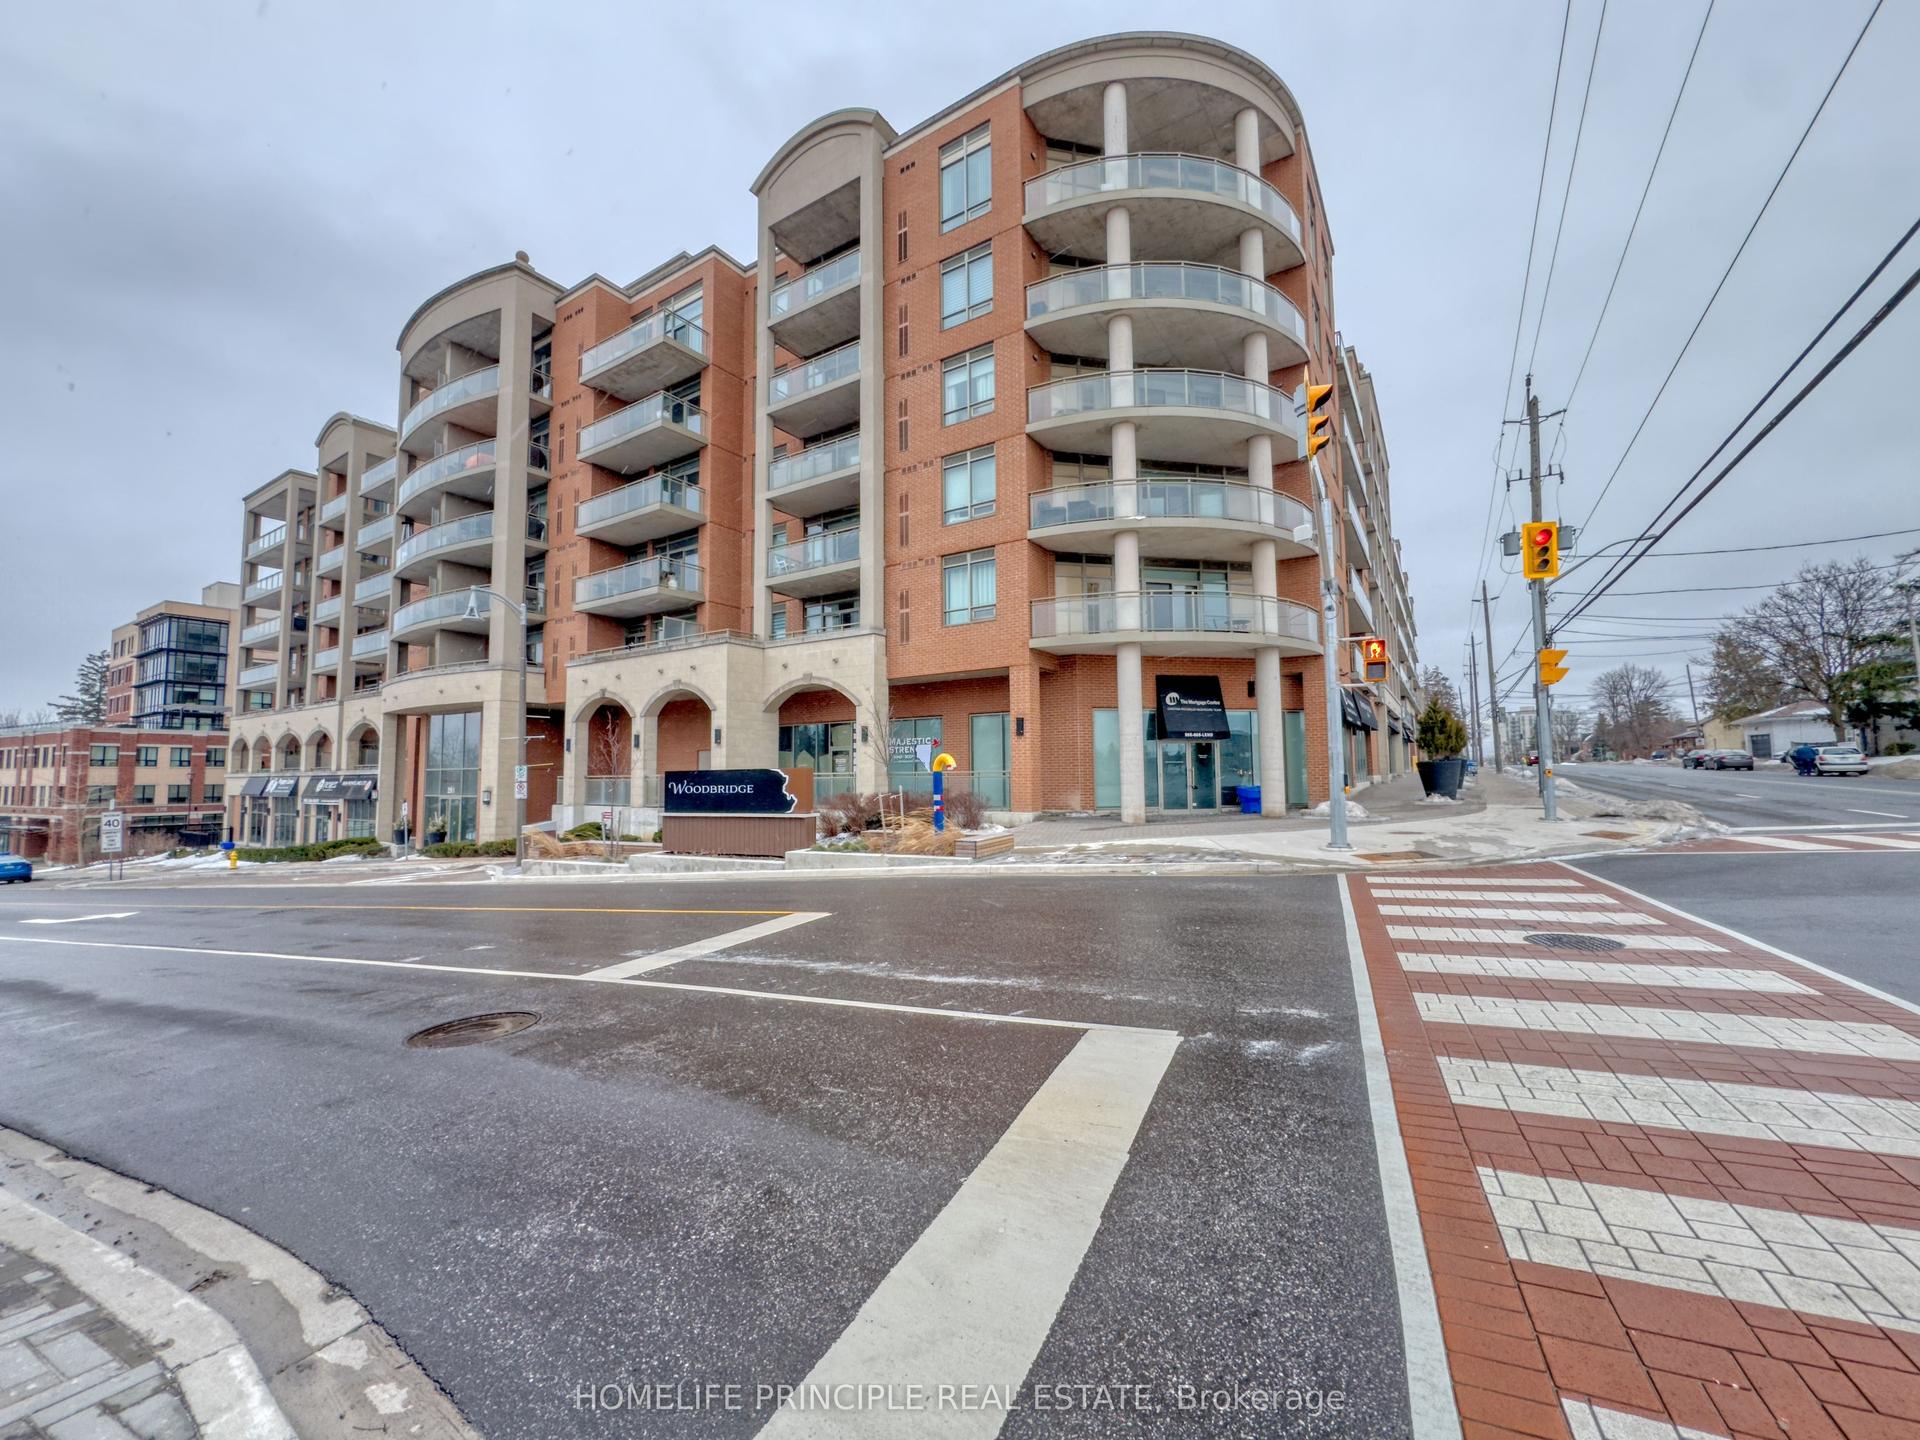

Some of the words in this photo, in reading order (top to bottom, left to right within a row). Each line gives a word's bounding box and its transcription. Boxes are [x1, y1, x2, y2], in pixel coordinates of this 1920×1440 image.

[889, 737, 931, 746] MAJESTIC
[889, 746, 916, 754] STREN
[103, 818, 120, 828] 40
